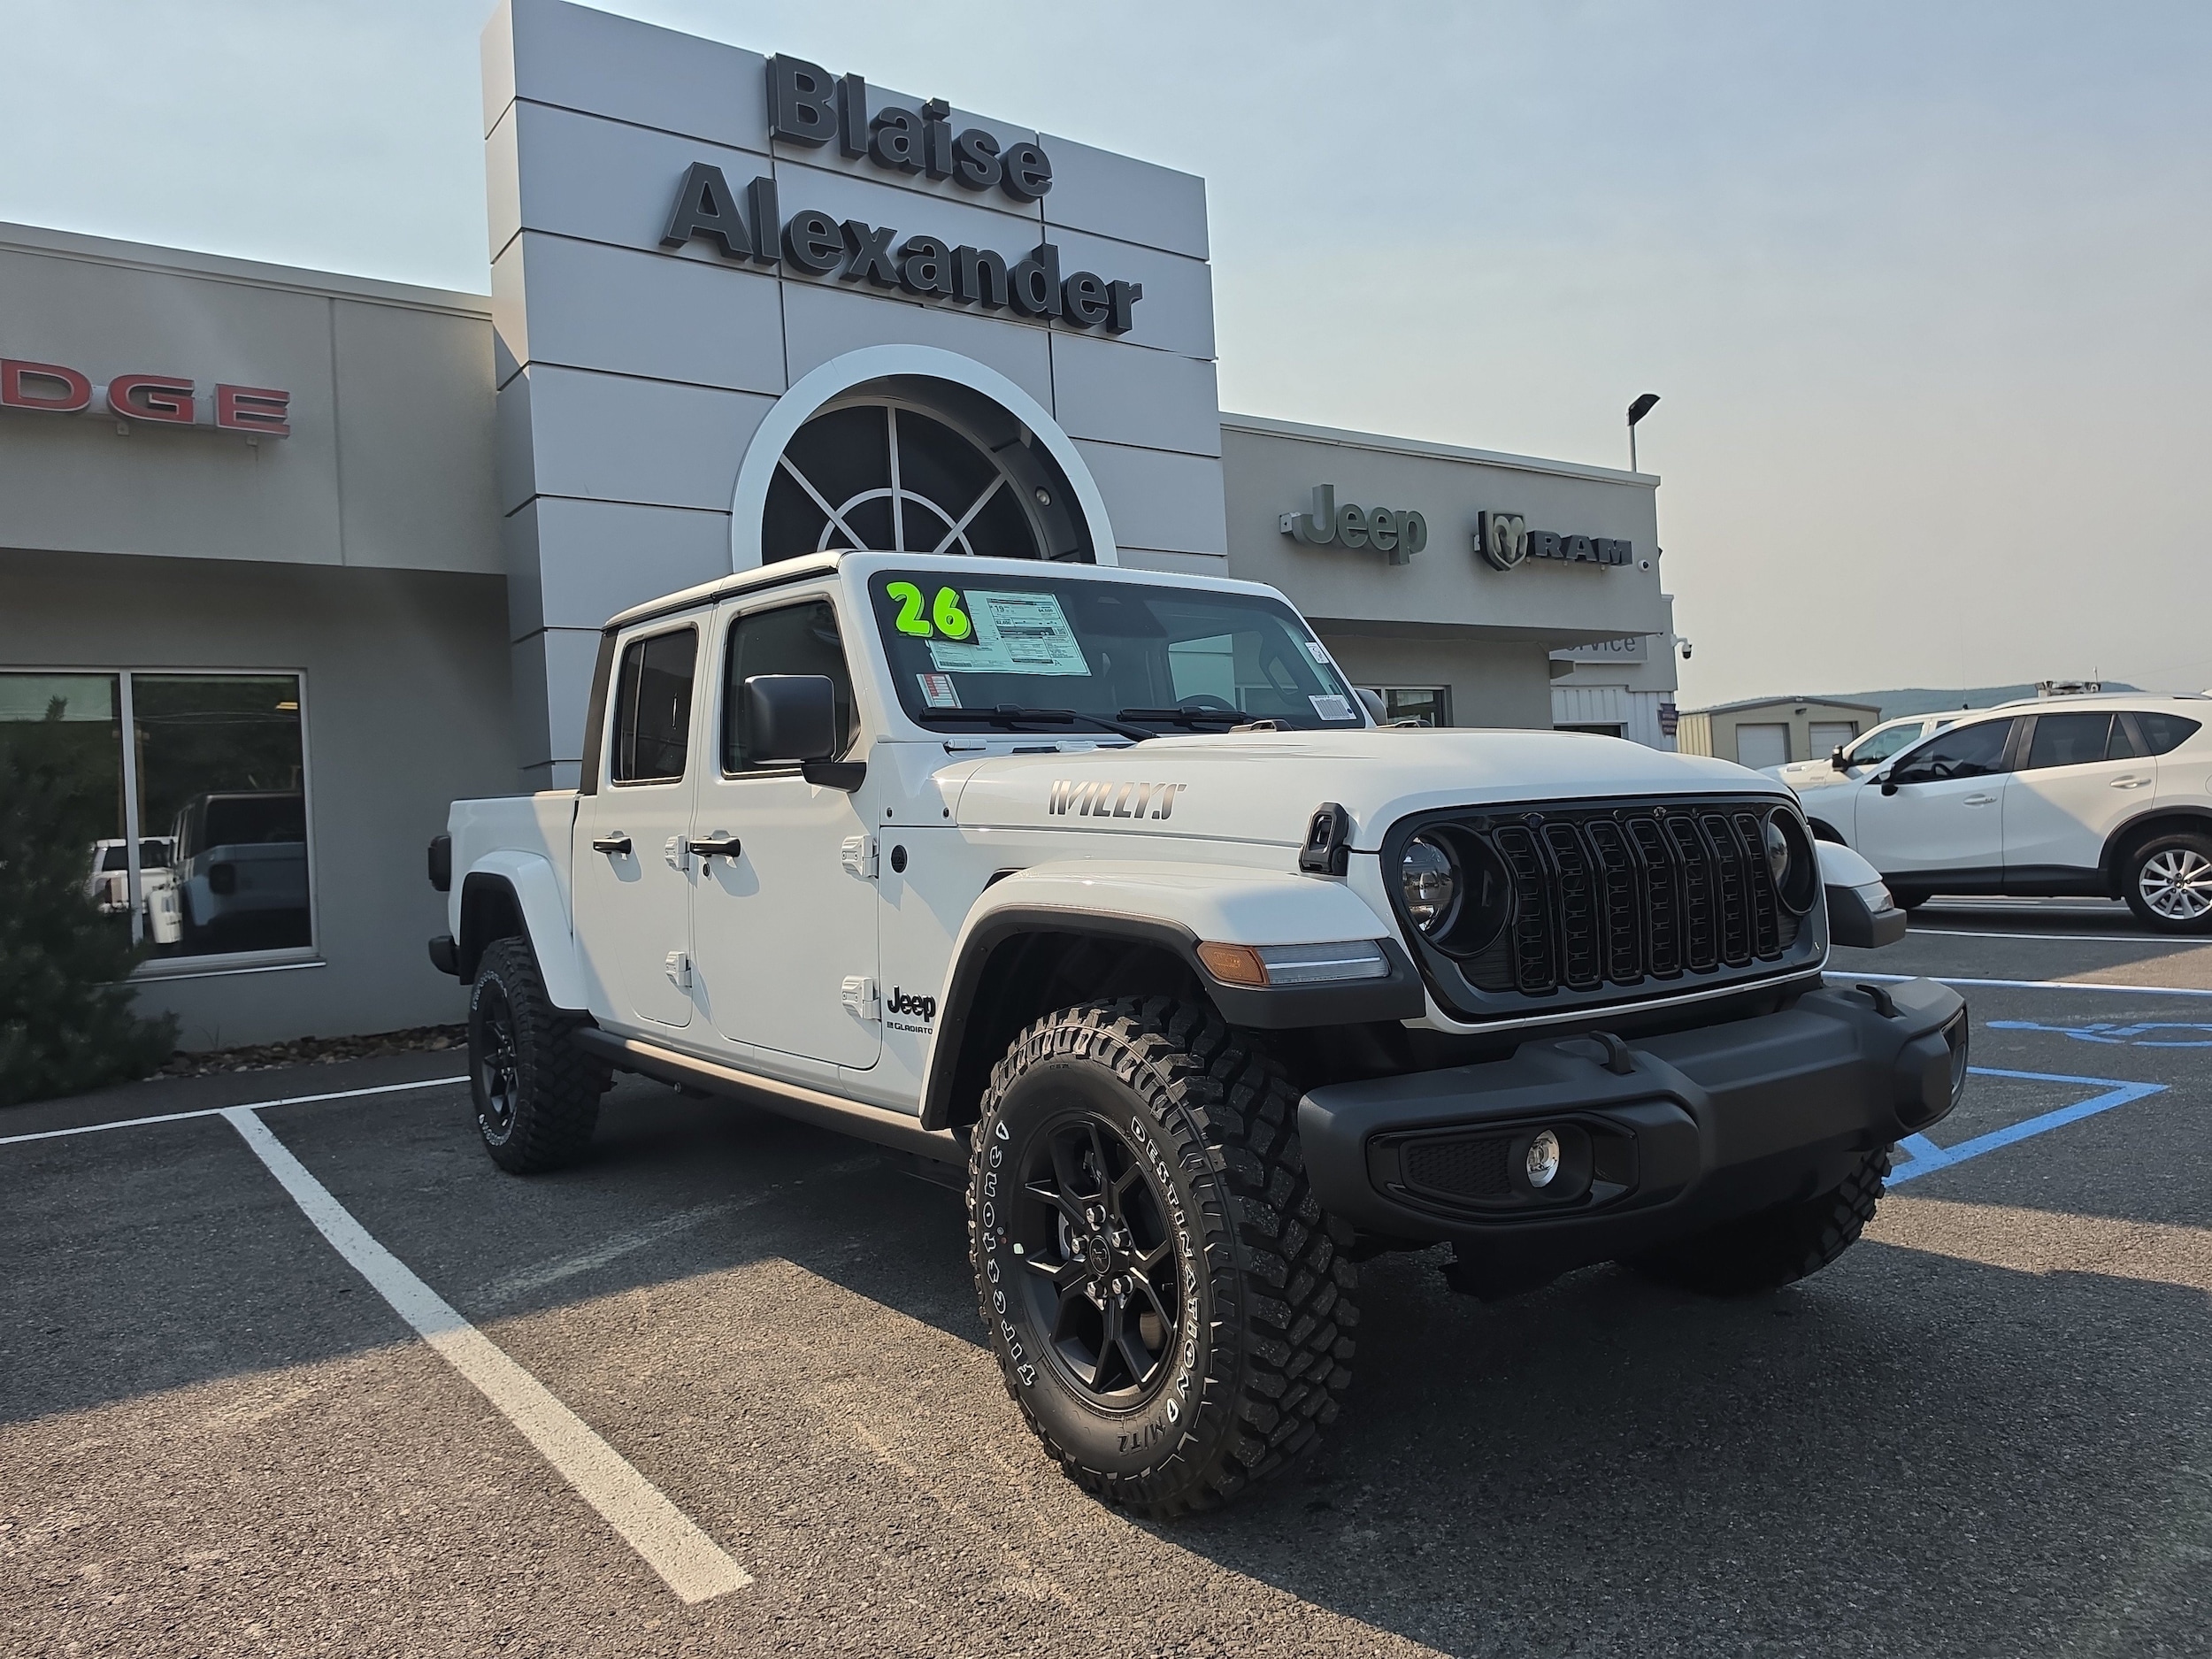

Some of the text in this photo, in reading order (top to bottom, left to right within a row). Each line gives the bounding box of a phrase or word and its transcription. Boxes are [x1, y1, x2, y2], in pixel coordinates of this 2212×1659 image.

[766, 52, 1054, 204] Blaise
[660, 162, 1142, 334] Alexander
[1292, 484, 1428, 565] Jeep
[1532, 530, 1633, 566] RAM
[887, 581, 972, 640] 26
[1048, 780, 1187, 820] WILLYS
[887, 985, 936, 1023] Jeep
[980, 1144, 1036, 1387] Firestone
[1130, 1115, 1199, 1400] DESTINATION
